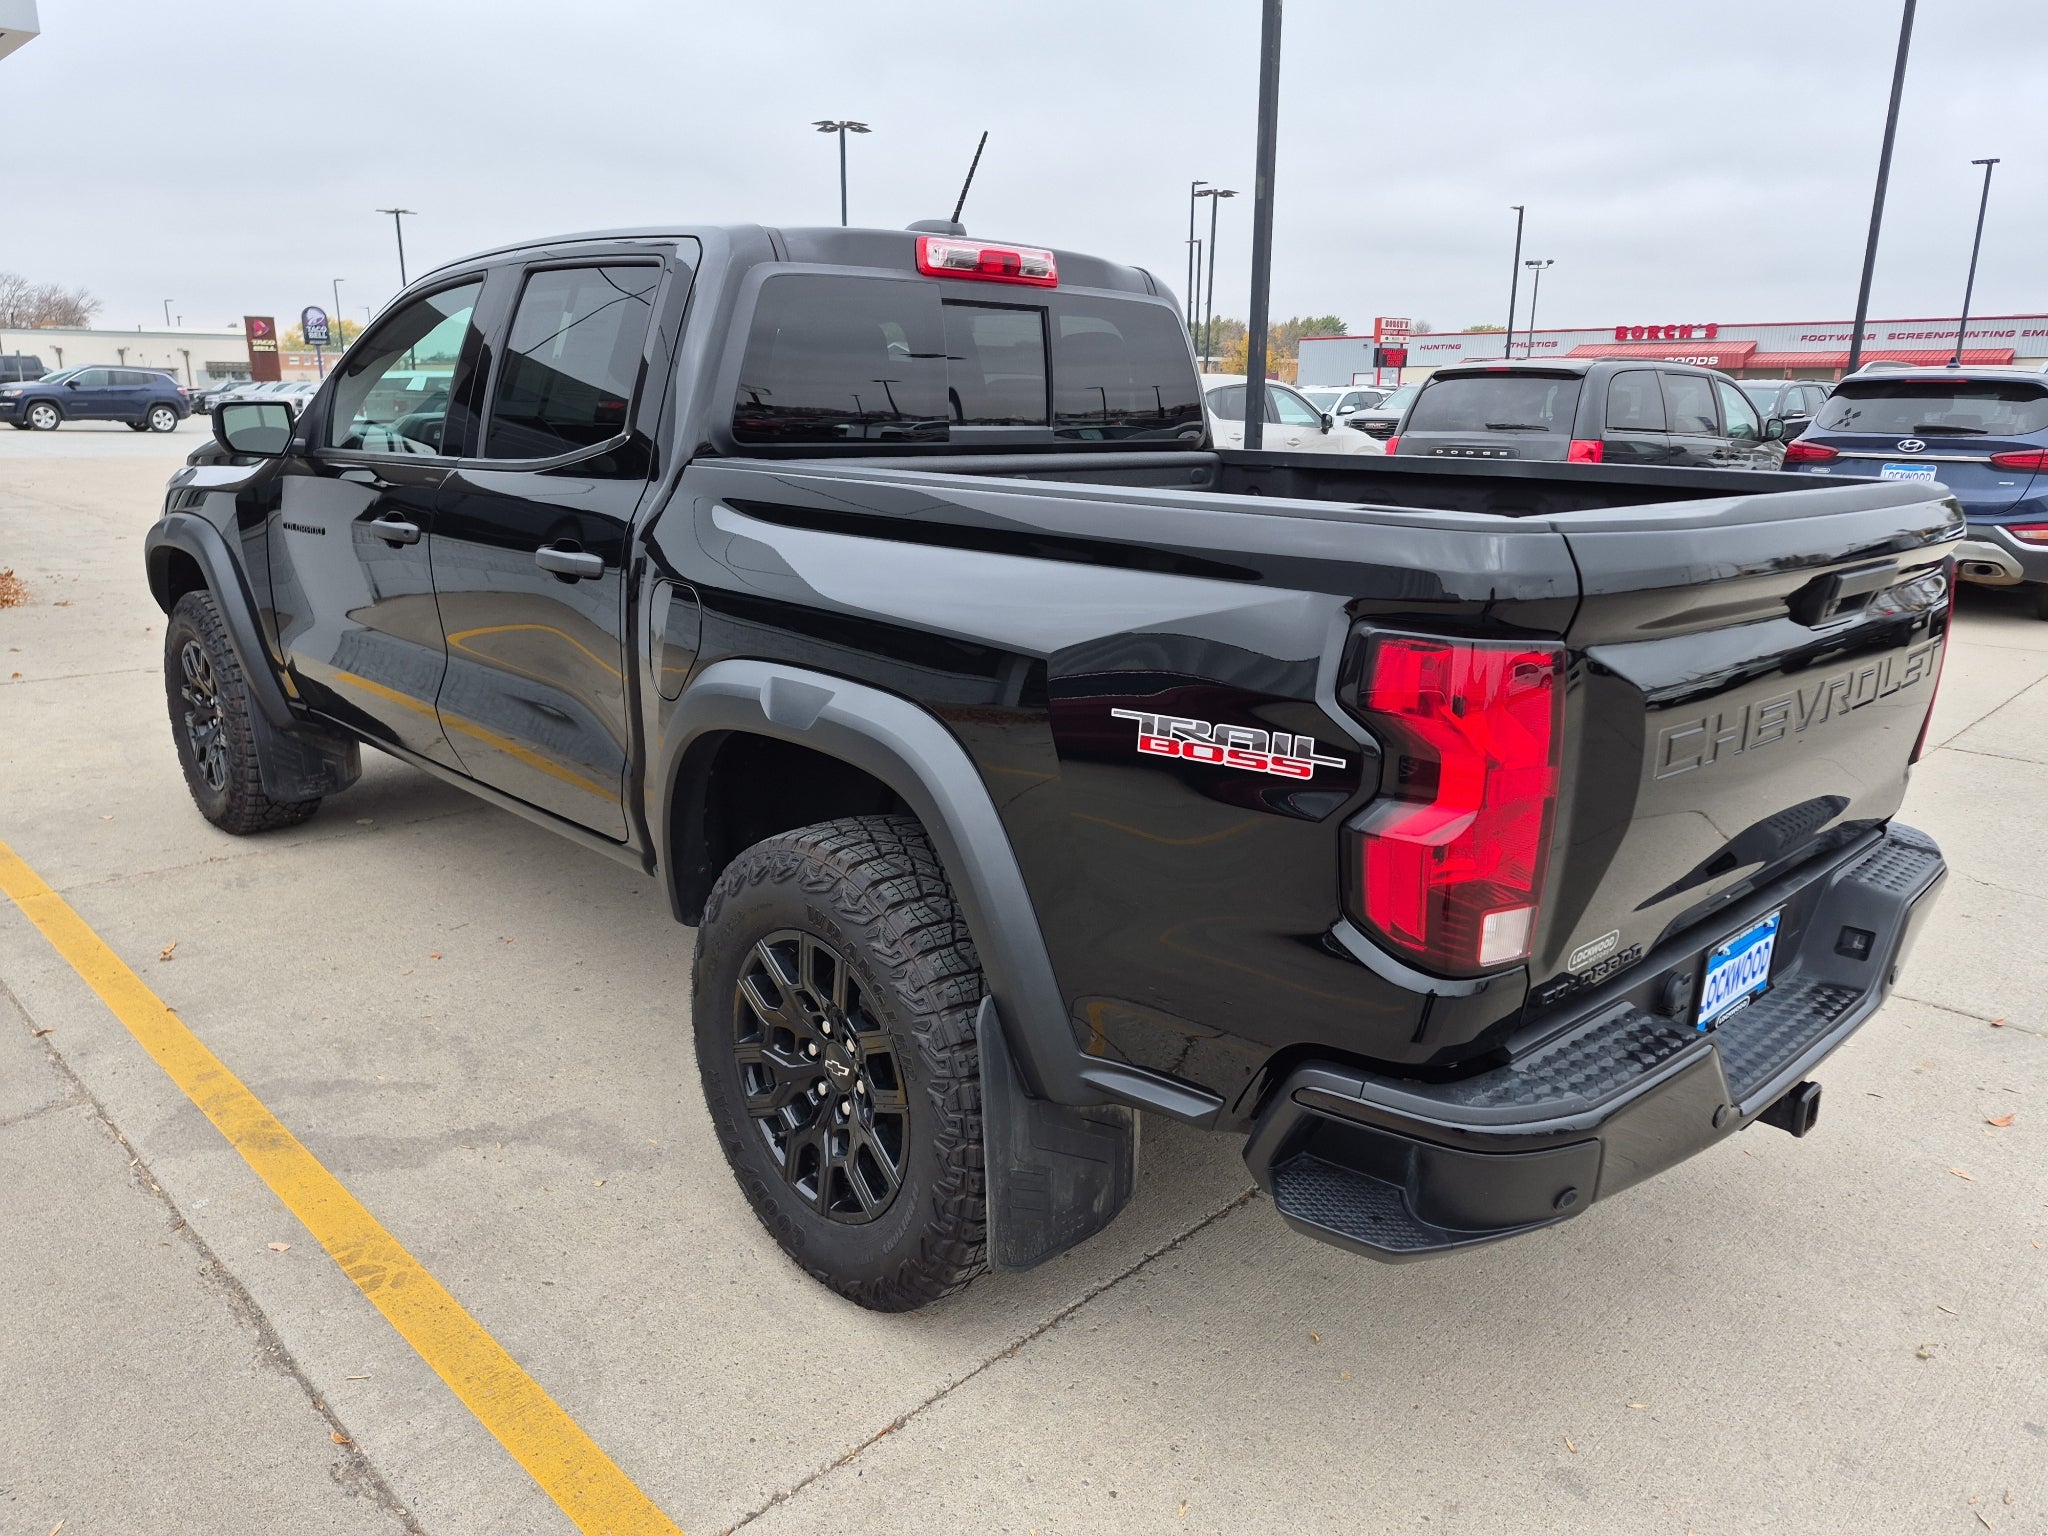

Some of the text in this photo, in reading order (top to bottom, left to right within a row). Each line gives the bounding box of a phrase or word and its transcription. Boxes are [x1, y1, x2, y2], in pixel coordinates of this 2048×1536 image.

[306, 325, 328, 333] TACO
[1419, 343, 1462, 351] HUNTING
[1615, 323, 1718, 341] BORCH'S
[1655, 634, 1943, 780] CHEVROLET
[1111, 708, 1347, 769] TRAIL
[1137, 735, 1315, 781] BOSS
[1571, 936, 1615, 965] LOCKWOOD
[806, 904, 917, 1081] WRANGLER
